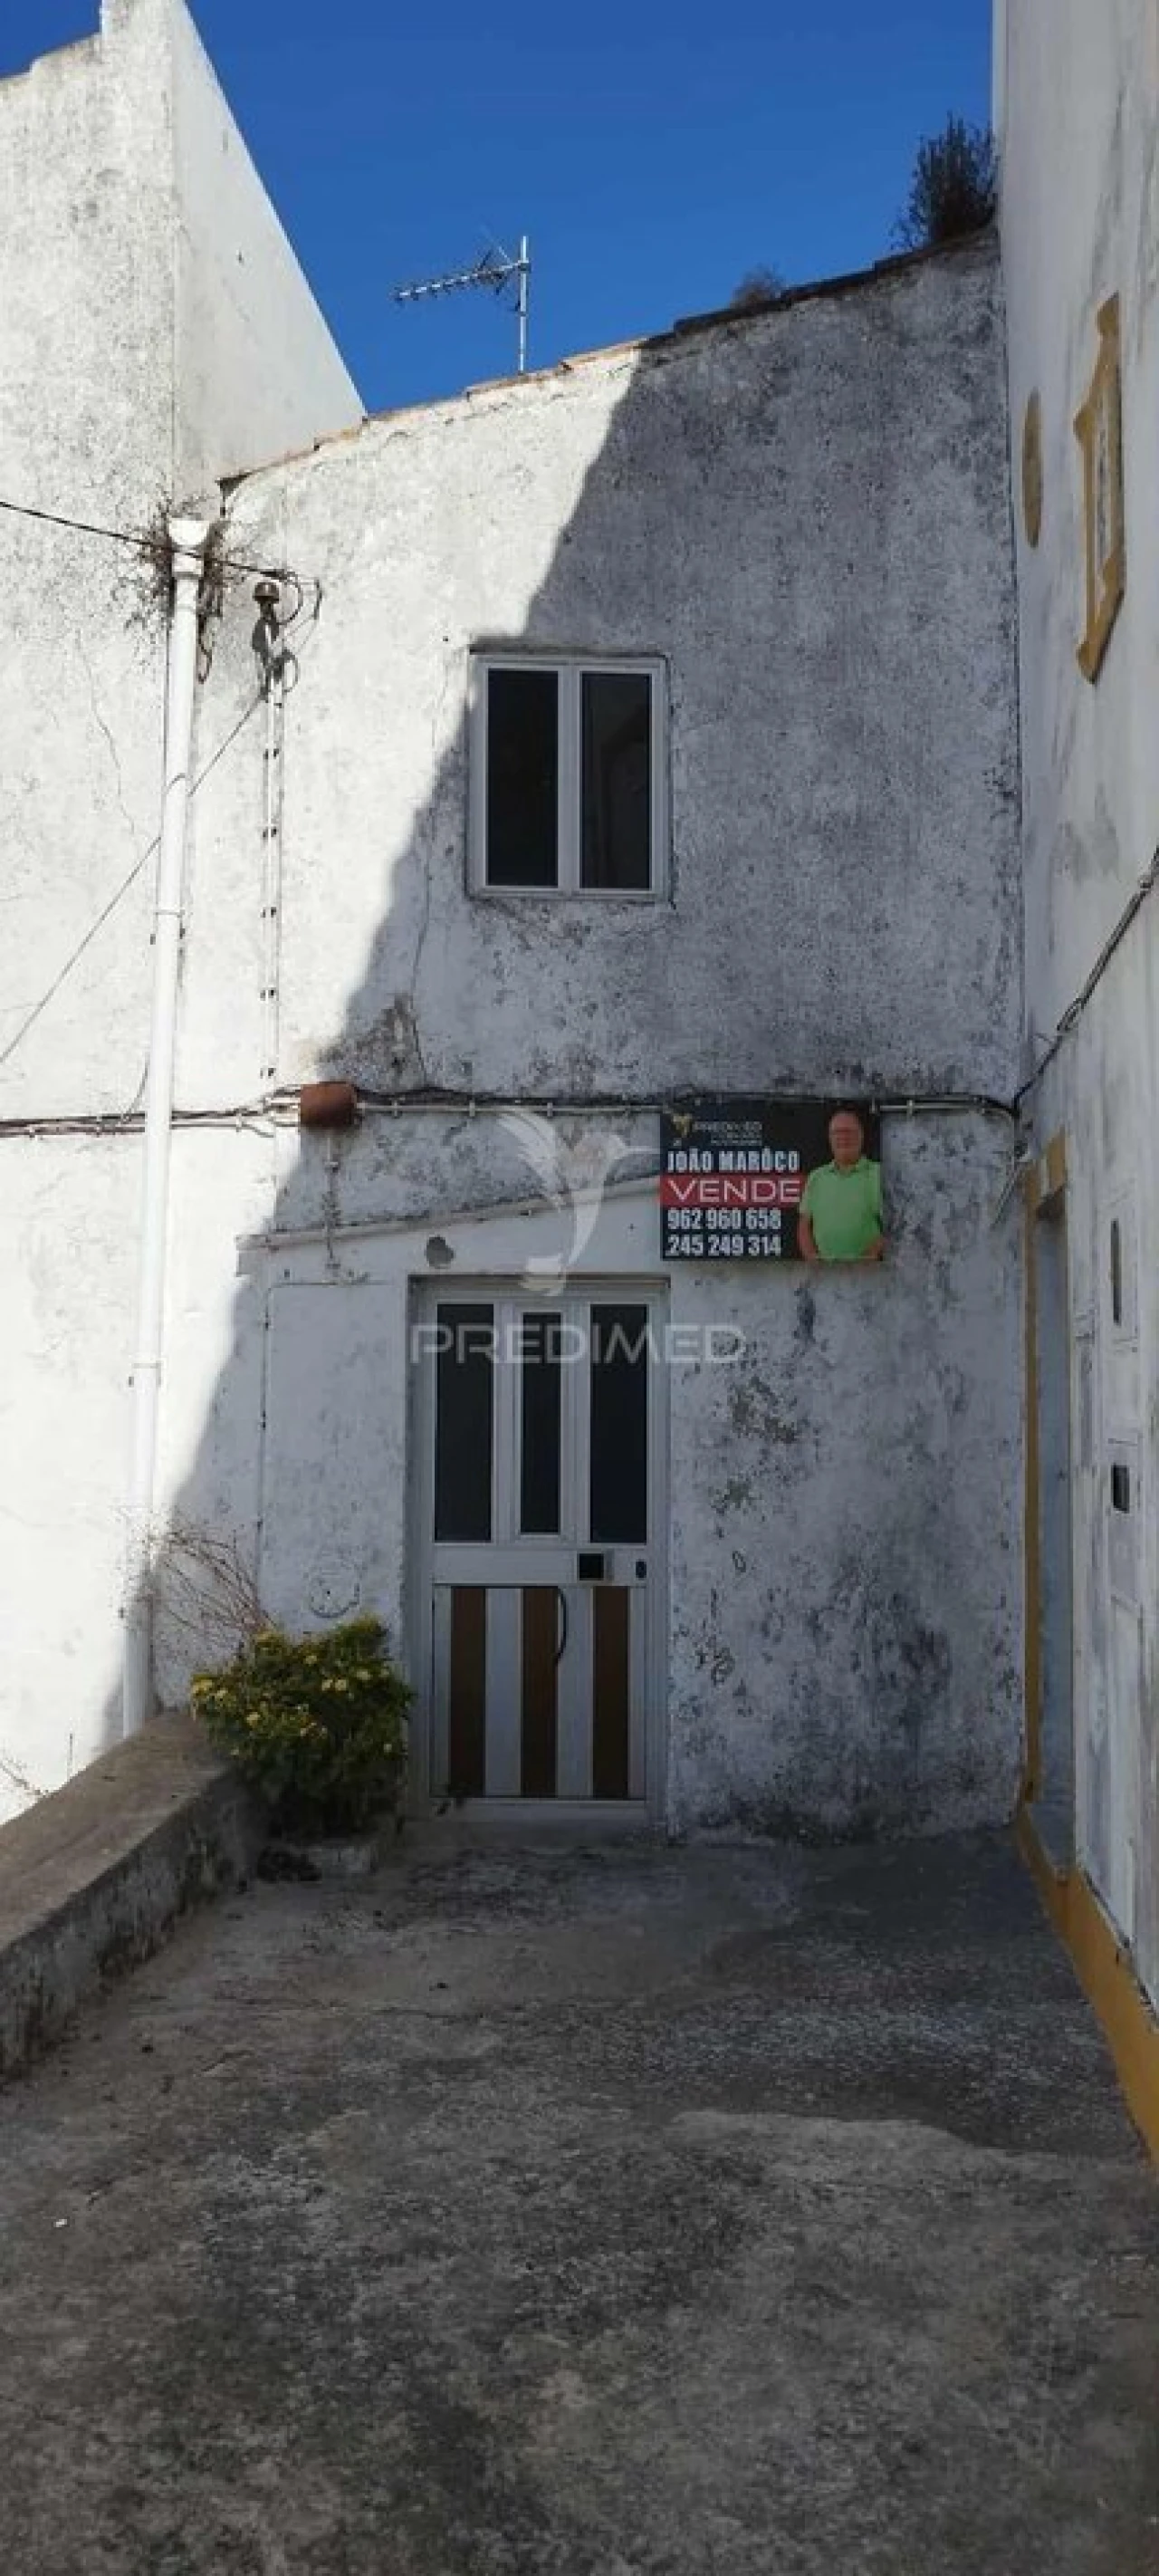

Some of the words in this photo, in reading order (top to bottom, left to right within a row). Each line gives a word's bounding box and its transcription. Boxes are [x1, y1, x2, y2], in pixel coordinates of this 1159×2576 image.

[667, 1148, 713, 1173] JOÃO
[719, 1147, 800, 1173] MARÔCO
[667, 1179, 800, 1203] VENDE
[667, 1207, 703, 1230] 962
[705, 1207, 741, 1230] 960
[745, 1207, 781, 1230] 658
[667, 1235, 704, 1257] 245
[707, 1235, 743, 1257] 249
[748, 1235, 781, 1257] 314
